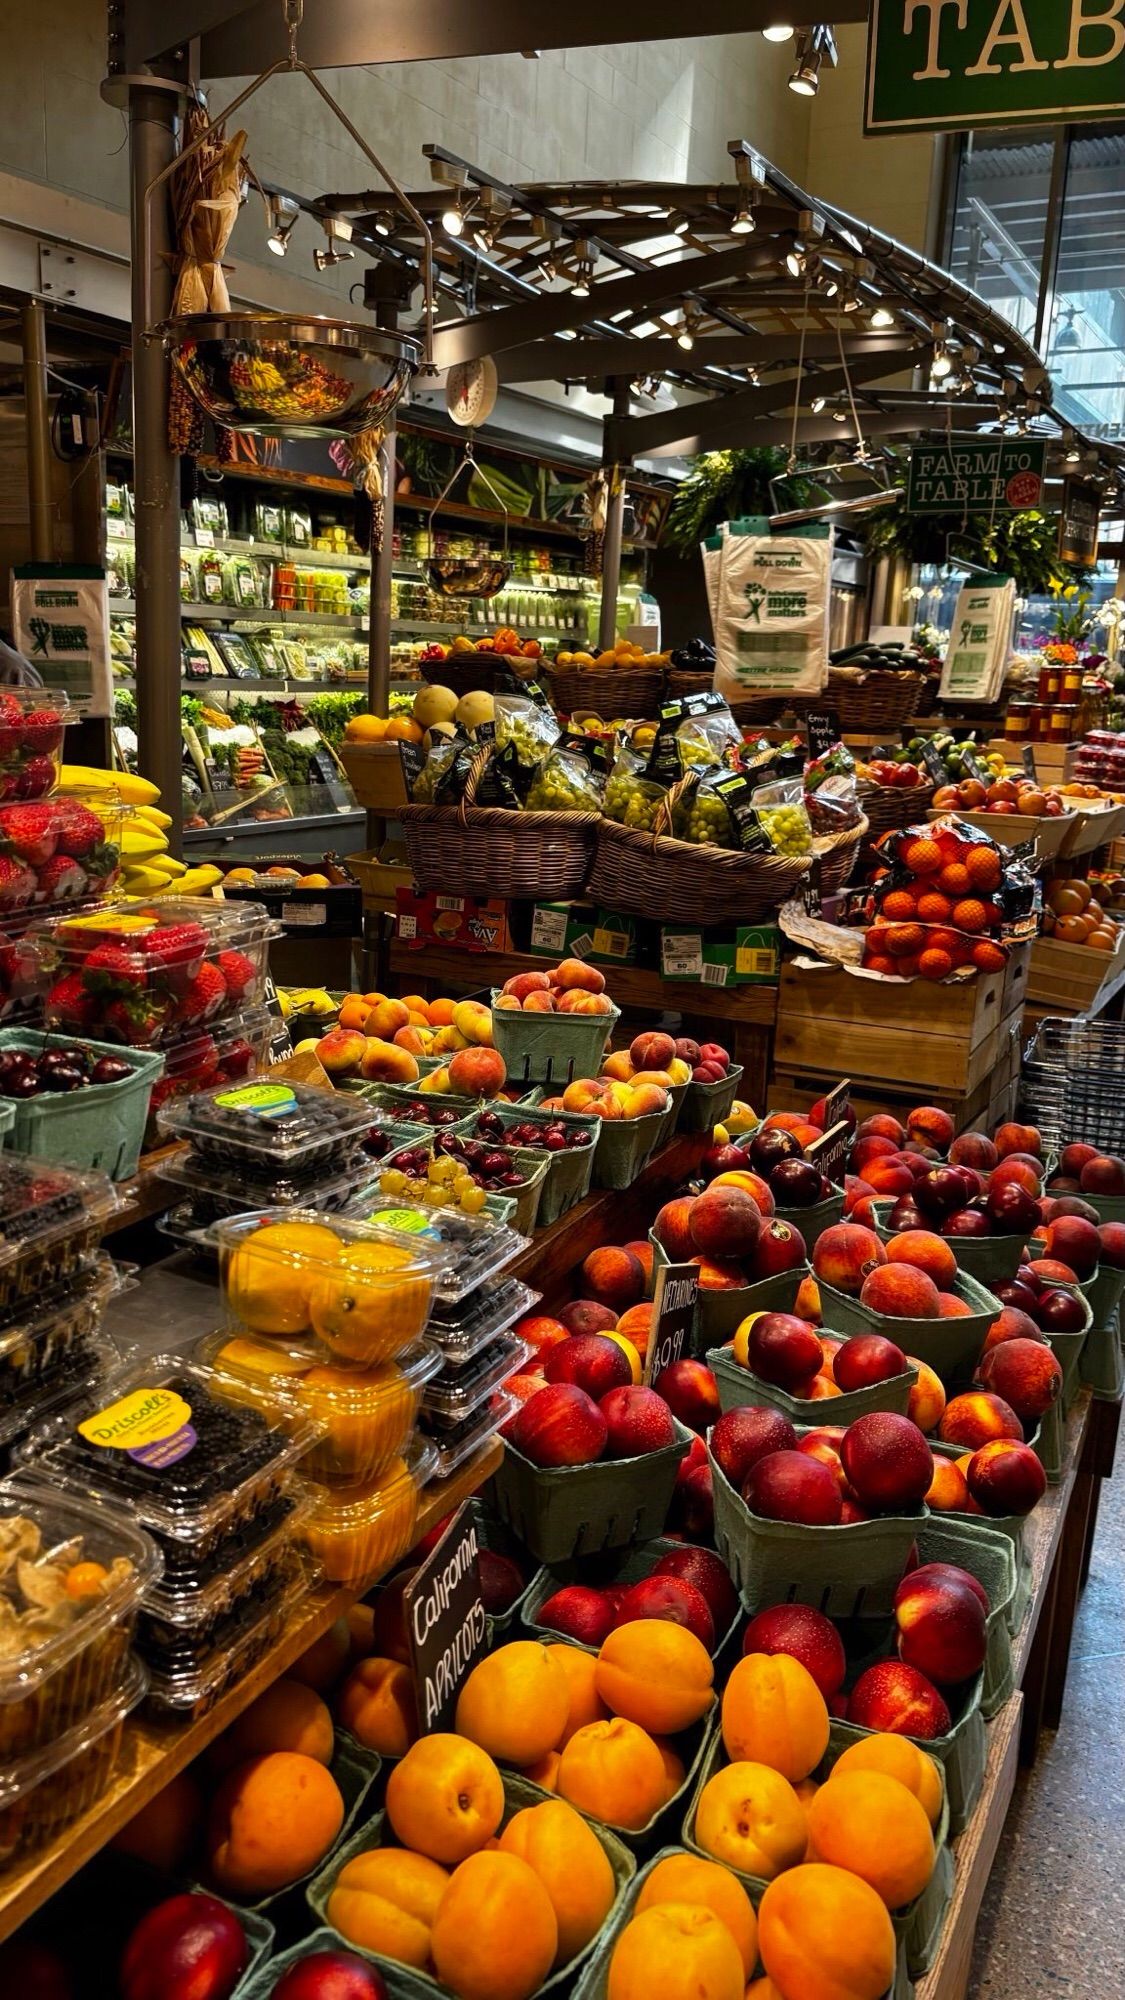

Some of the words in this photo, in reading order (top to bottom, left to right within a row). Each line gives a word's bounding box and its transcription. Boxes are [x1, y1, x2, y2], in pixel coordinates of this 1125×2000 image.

[917, 452, 998, 477] FARM
[1004, 453, 1032, 471] TO
[915, 478, 1006, 502] TABLE
[754, 556, 774, 567] PULL
[775, 556, 802, 567] DOWN
[768, 596, 807, 609] more
[92, 1393, 171, 1440] Driscoll's
[413, 1526, 479, 1647] California
[425, 1597, 486, 1729] APRICOTS
